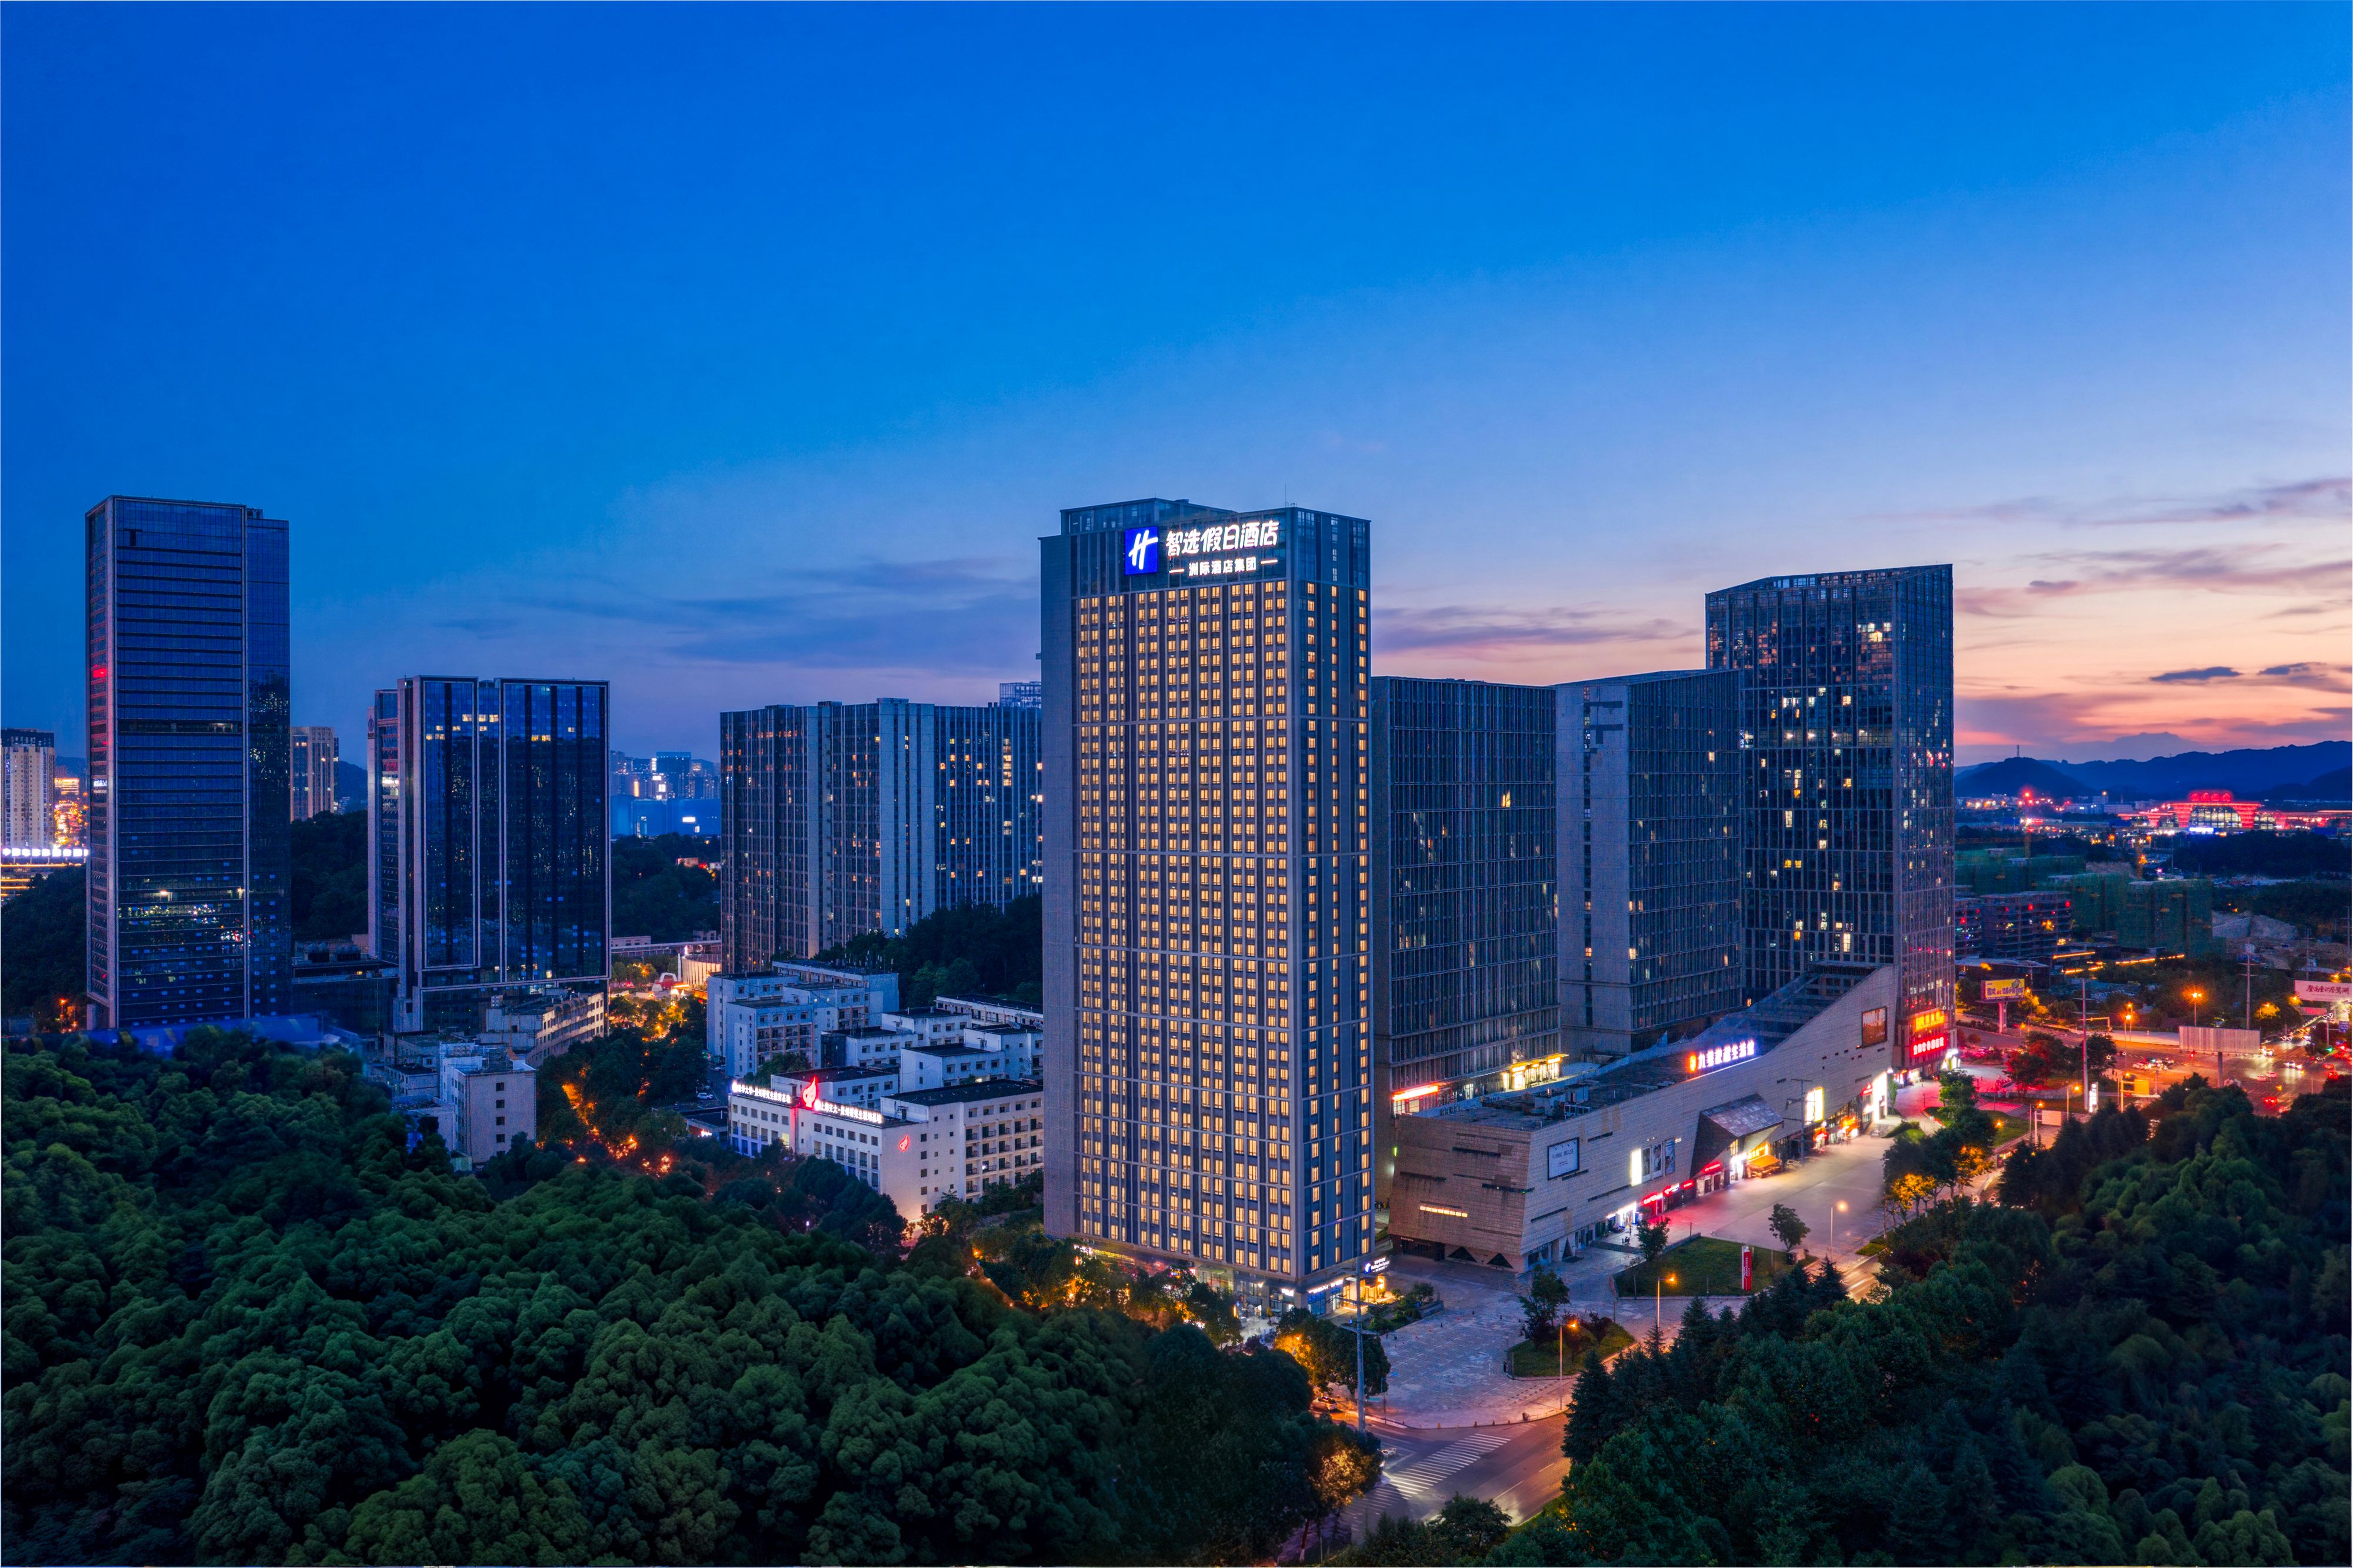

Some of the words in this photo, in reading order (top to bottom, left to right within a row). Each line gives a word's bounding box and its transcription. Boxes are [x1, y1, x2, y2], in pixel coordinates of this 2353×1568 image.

[1166, 521, 1279, 556] 智选假日酒店
[1188, 556, 1257, 576] 洲际酒店集团
